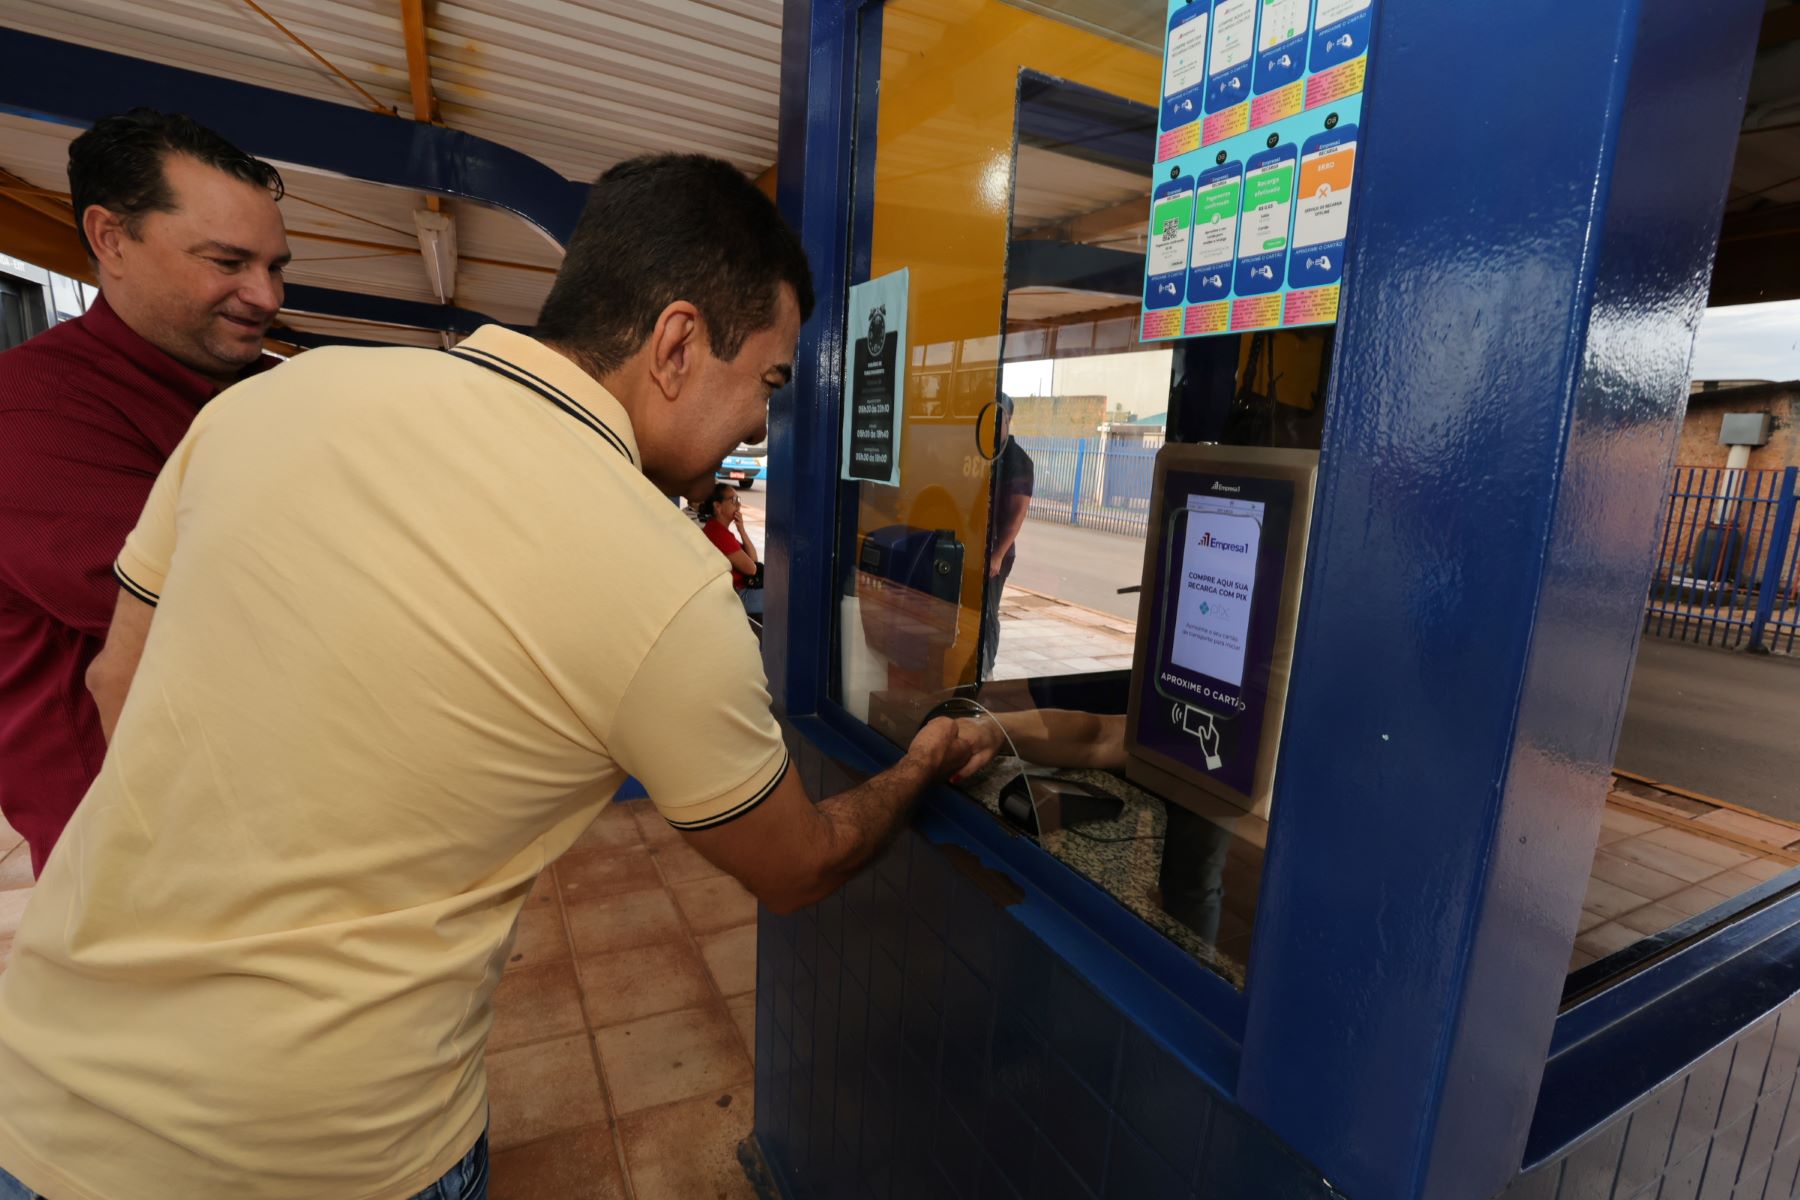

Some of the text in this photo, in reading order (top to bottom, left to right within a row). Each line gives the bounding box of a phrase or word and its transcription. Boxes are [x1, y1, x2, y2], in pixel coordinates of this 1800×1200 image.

[1317, 161, 1335, 172] ERRO
[1187, 581, 1248, 601] RECARGA COM PIX
[1188, 571, 1249, 591] COMPRE AQUI SUA
[1160, 672, 1246, 711] APROXIME O CARTÃO
